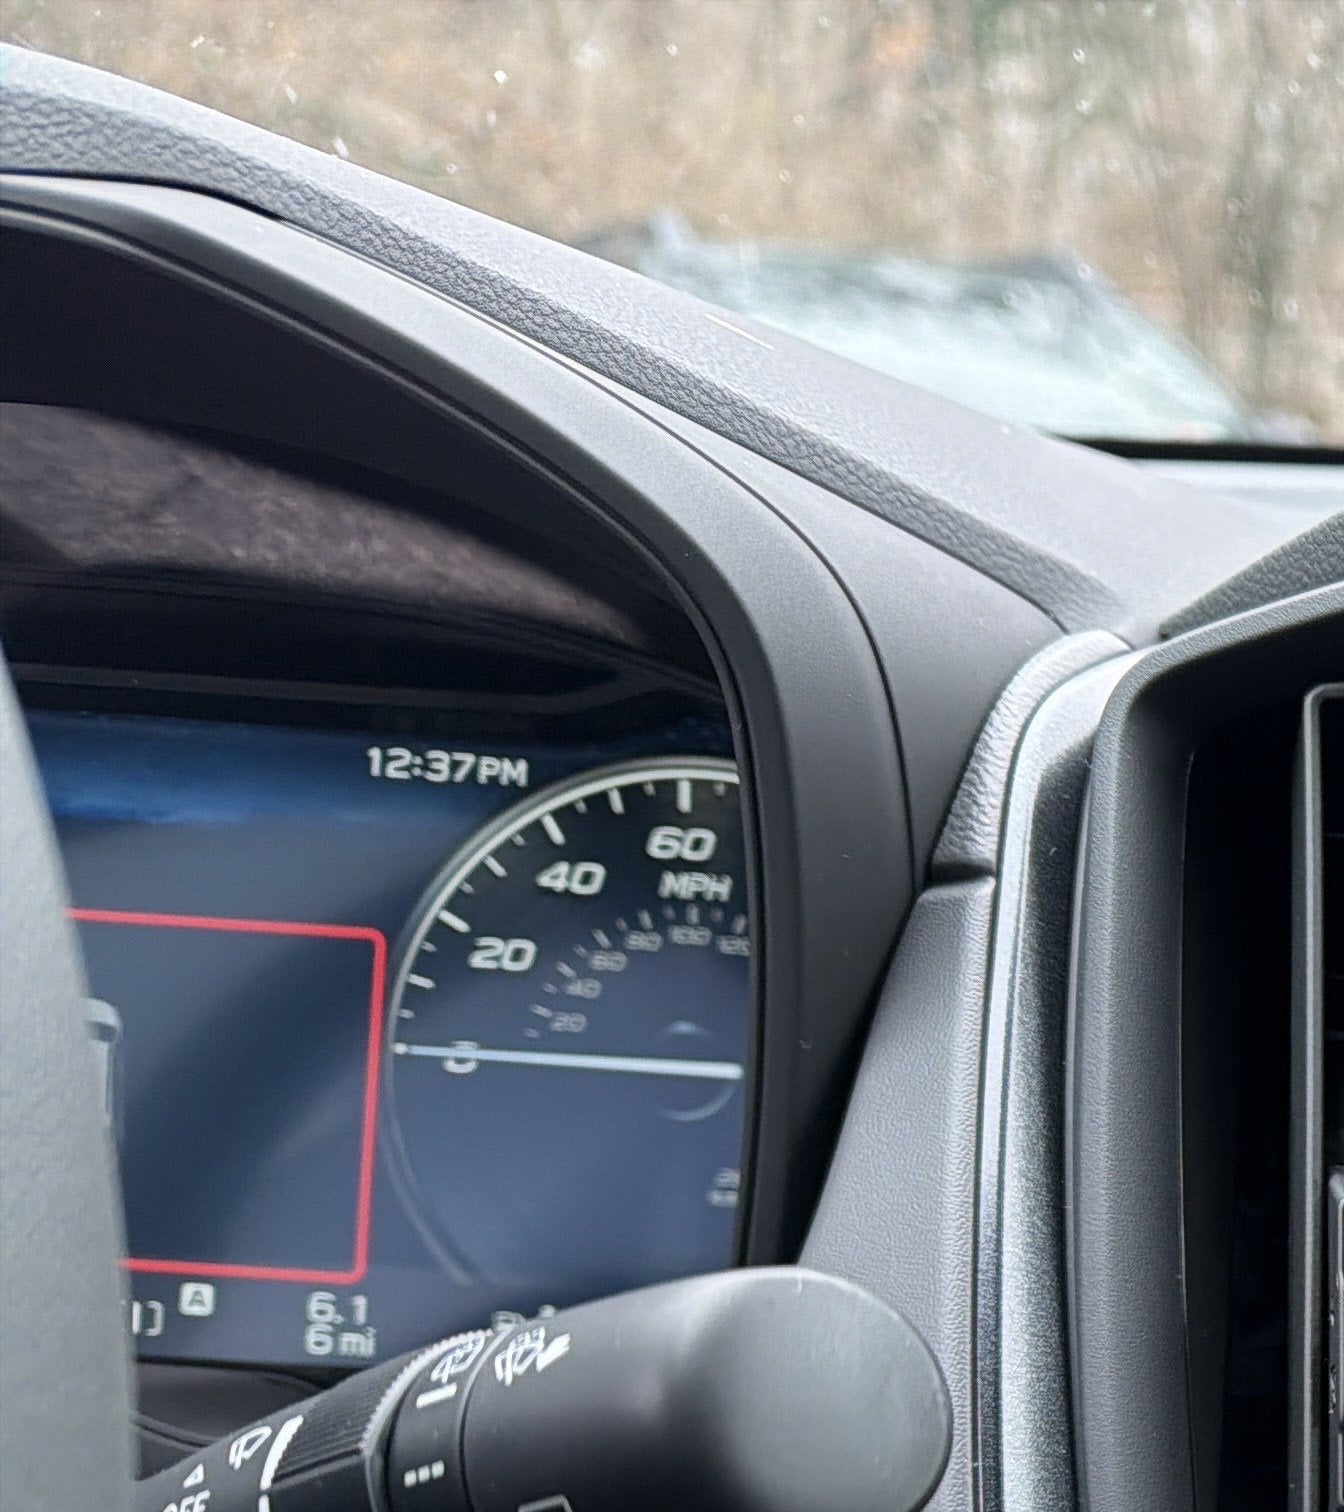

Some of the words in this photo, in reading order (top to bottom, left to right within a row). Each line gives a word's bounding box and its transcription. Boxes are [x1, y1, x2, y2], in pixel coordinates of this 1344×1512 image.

[646, 825, 717, 861] 60
[536, 860, 607, 896] 40
[658, 870, 734, 902] MPH
[468, 936, 537, 972] 20
[306, 1290, 368, 1326] 6.1
